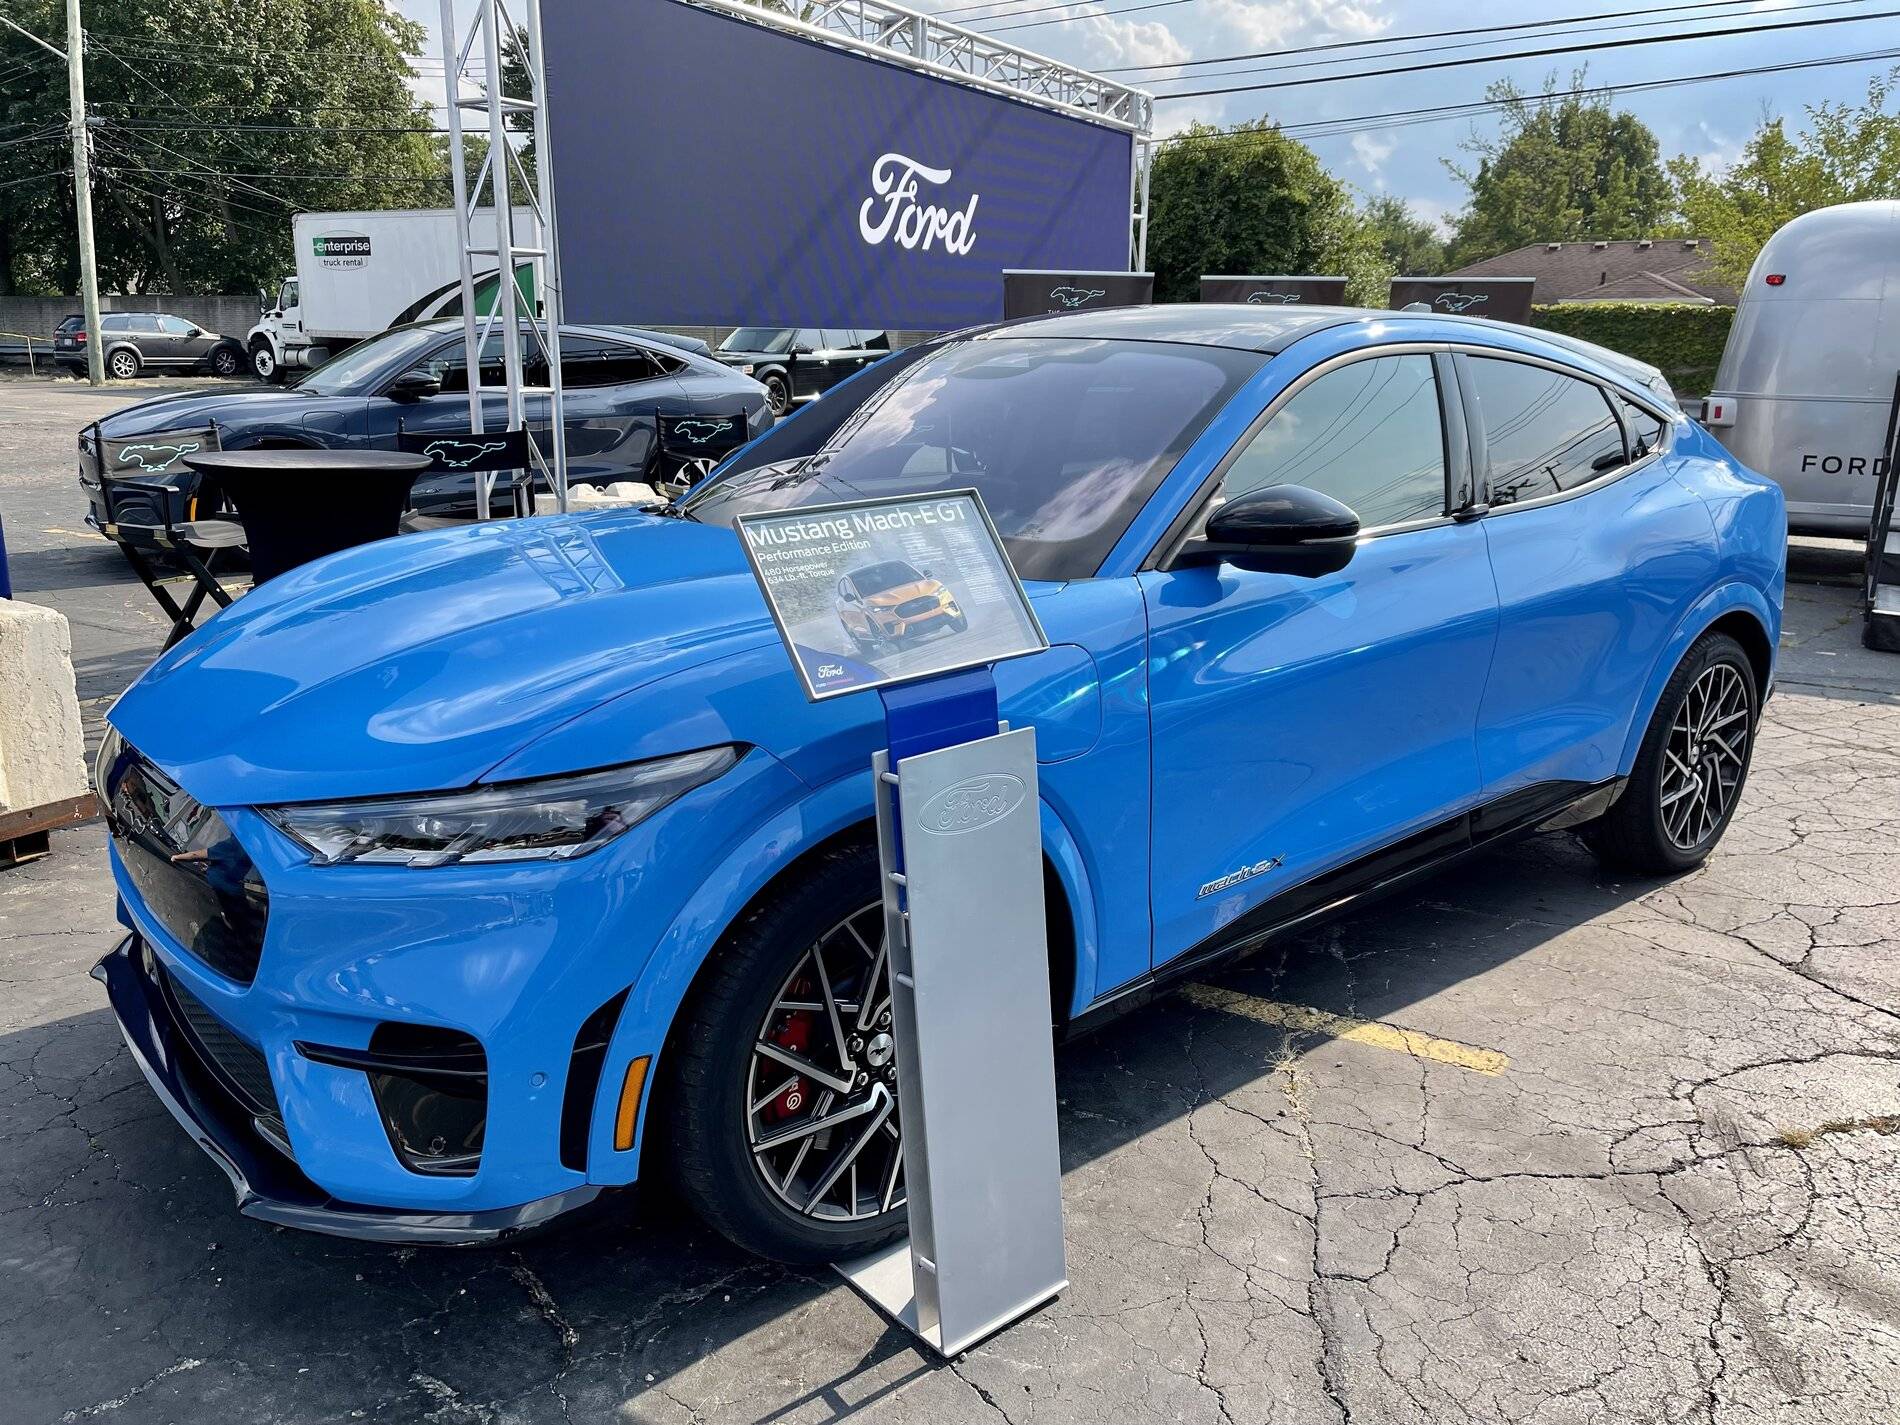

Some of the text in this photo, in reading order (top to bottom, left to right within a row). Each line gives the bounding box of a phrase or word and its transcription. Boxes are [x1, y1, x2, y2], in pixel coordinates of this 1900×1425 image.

[860, 153, 979, 255] Ford
[315, 240, 370, 254] enterprise
[323, 257, 364, 267] truck rental
[745, 501, 966, 547] Mustang Mach-E GT
[757, 539, 871, 563] Performance Edition
[765, 562, 828, 577] 480 Horsepower
[767, 575, 784, 585] 634
[809, 568, 835, 578] Torque
[818, 664, 844, 679] Ford
[938, 781, 1008, 830] Ford
